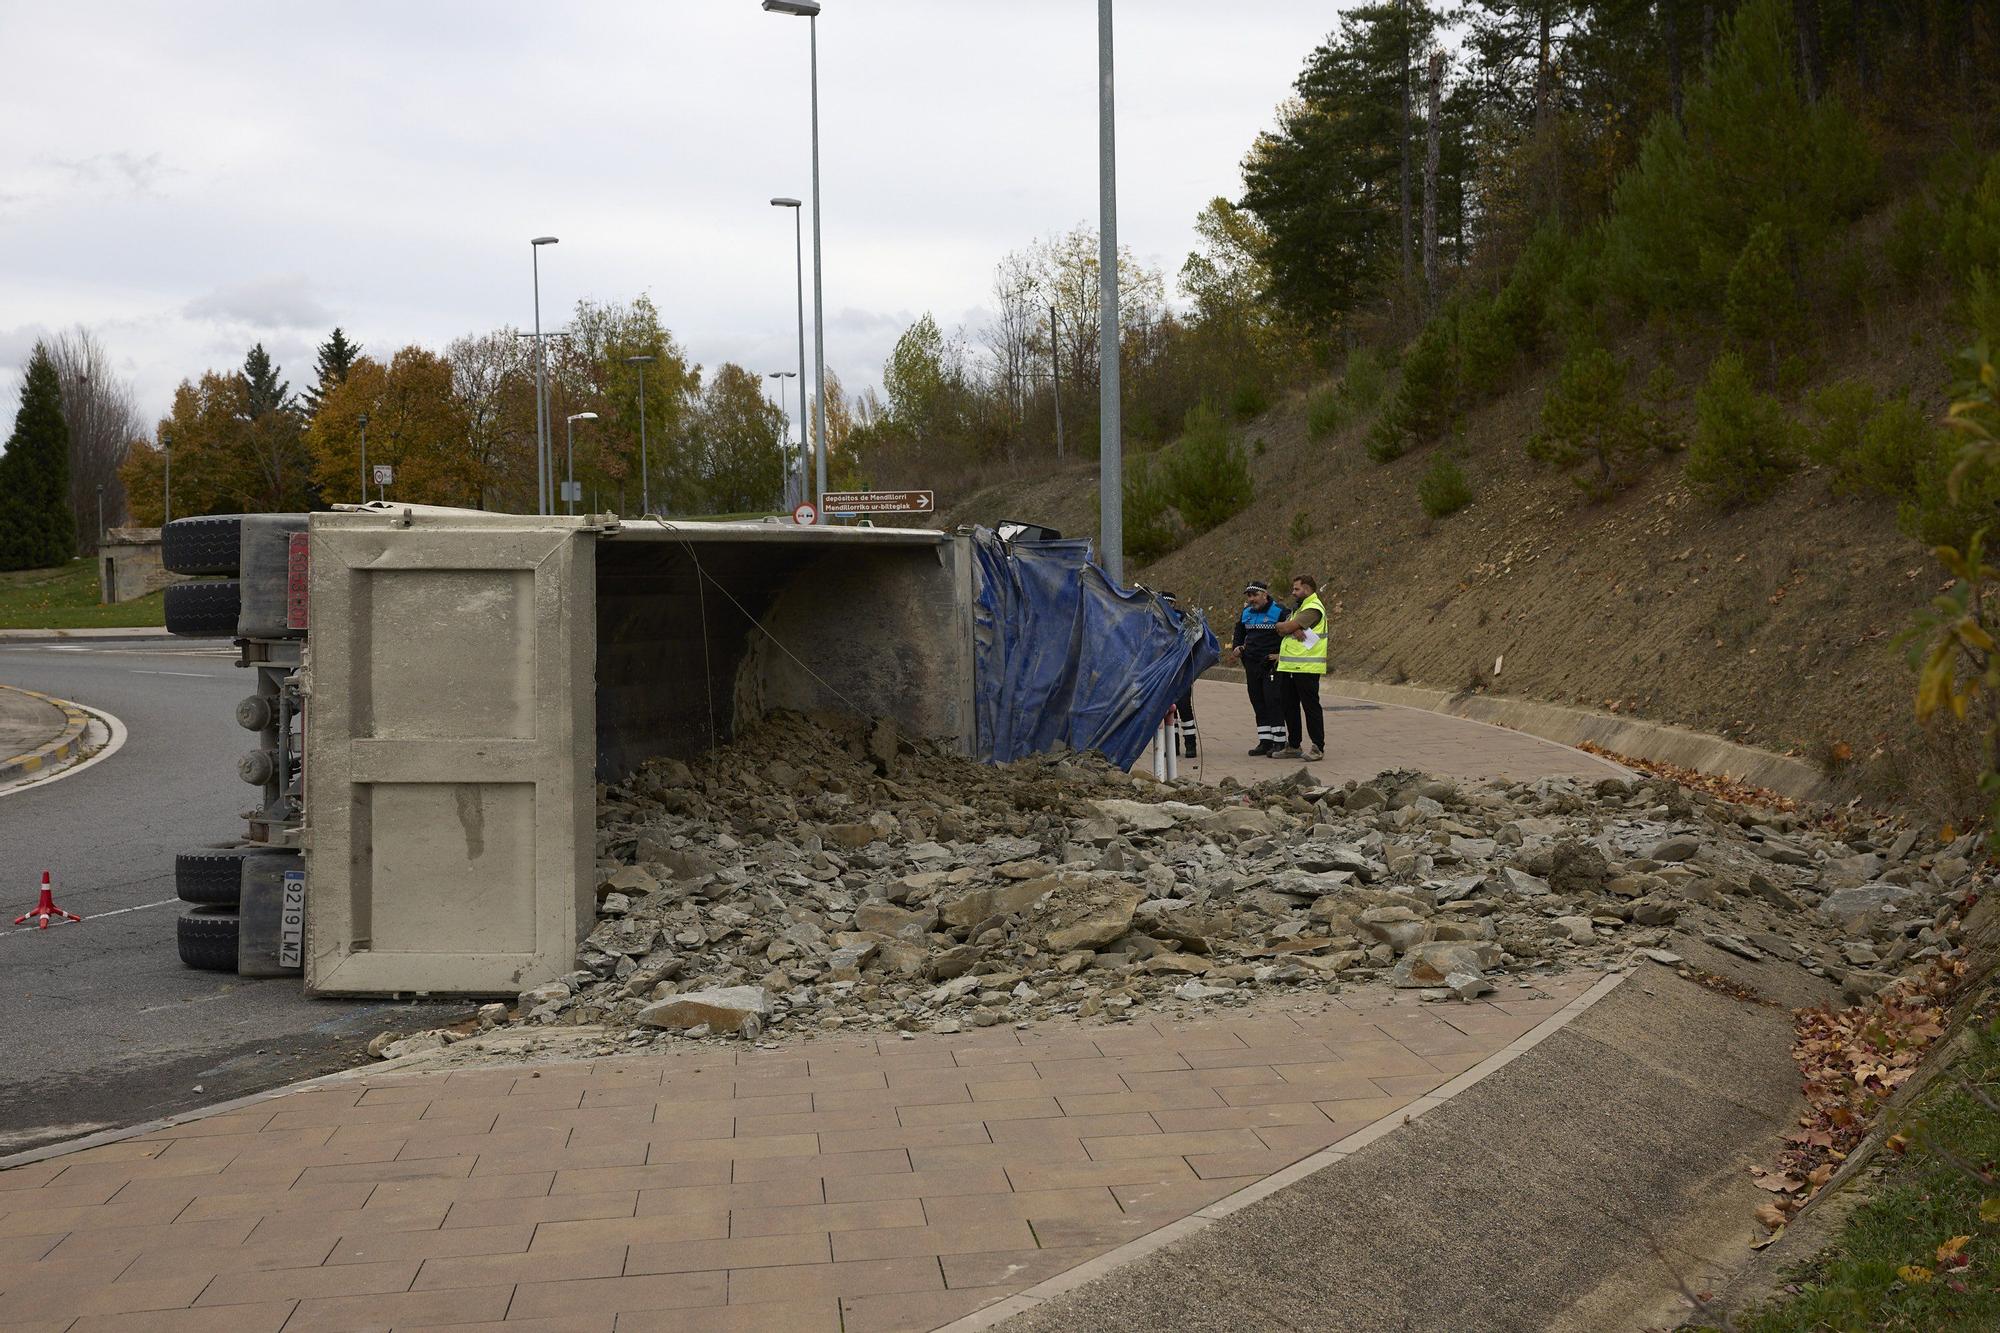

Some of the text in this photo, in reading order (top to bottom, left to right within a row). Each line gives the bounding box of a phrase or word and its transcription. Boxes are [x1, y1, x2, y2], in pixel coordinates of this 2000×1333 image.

[825, 503, 911, 511] Mendillorriko ur-biltegiak
[282, 882, 302, 962] 9219 LMZ
